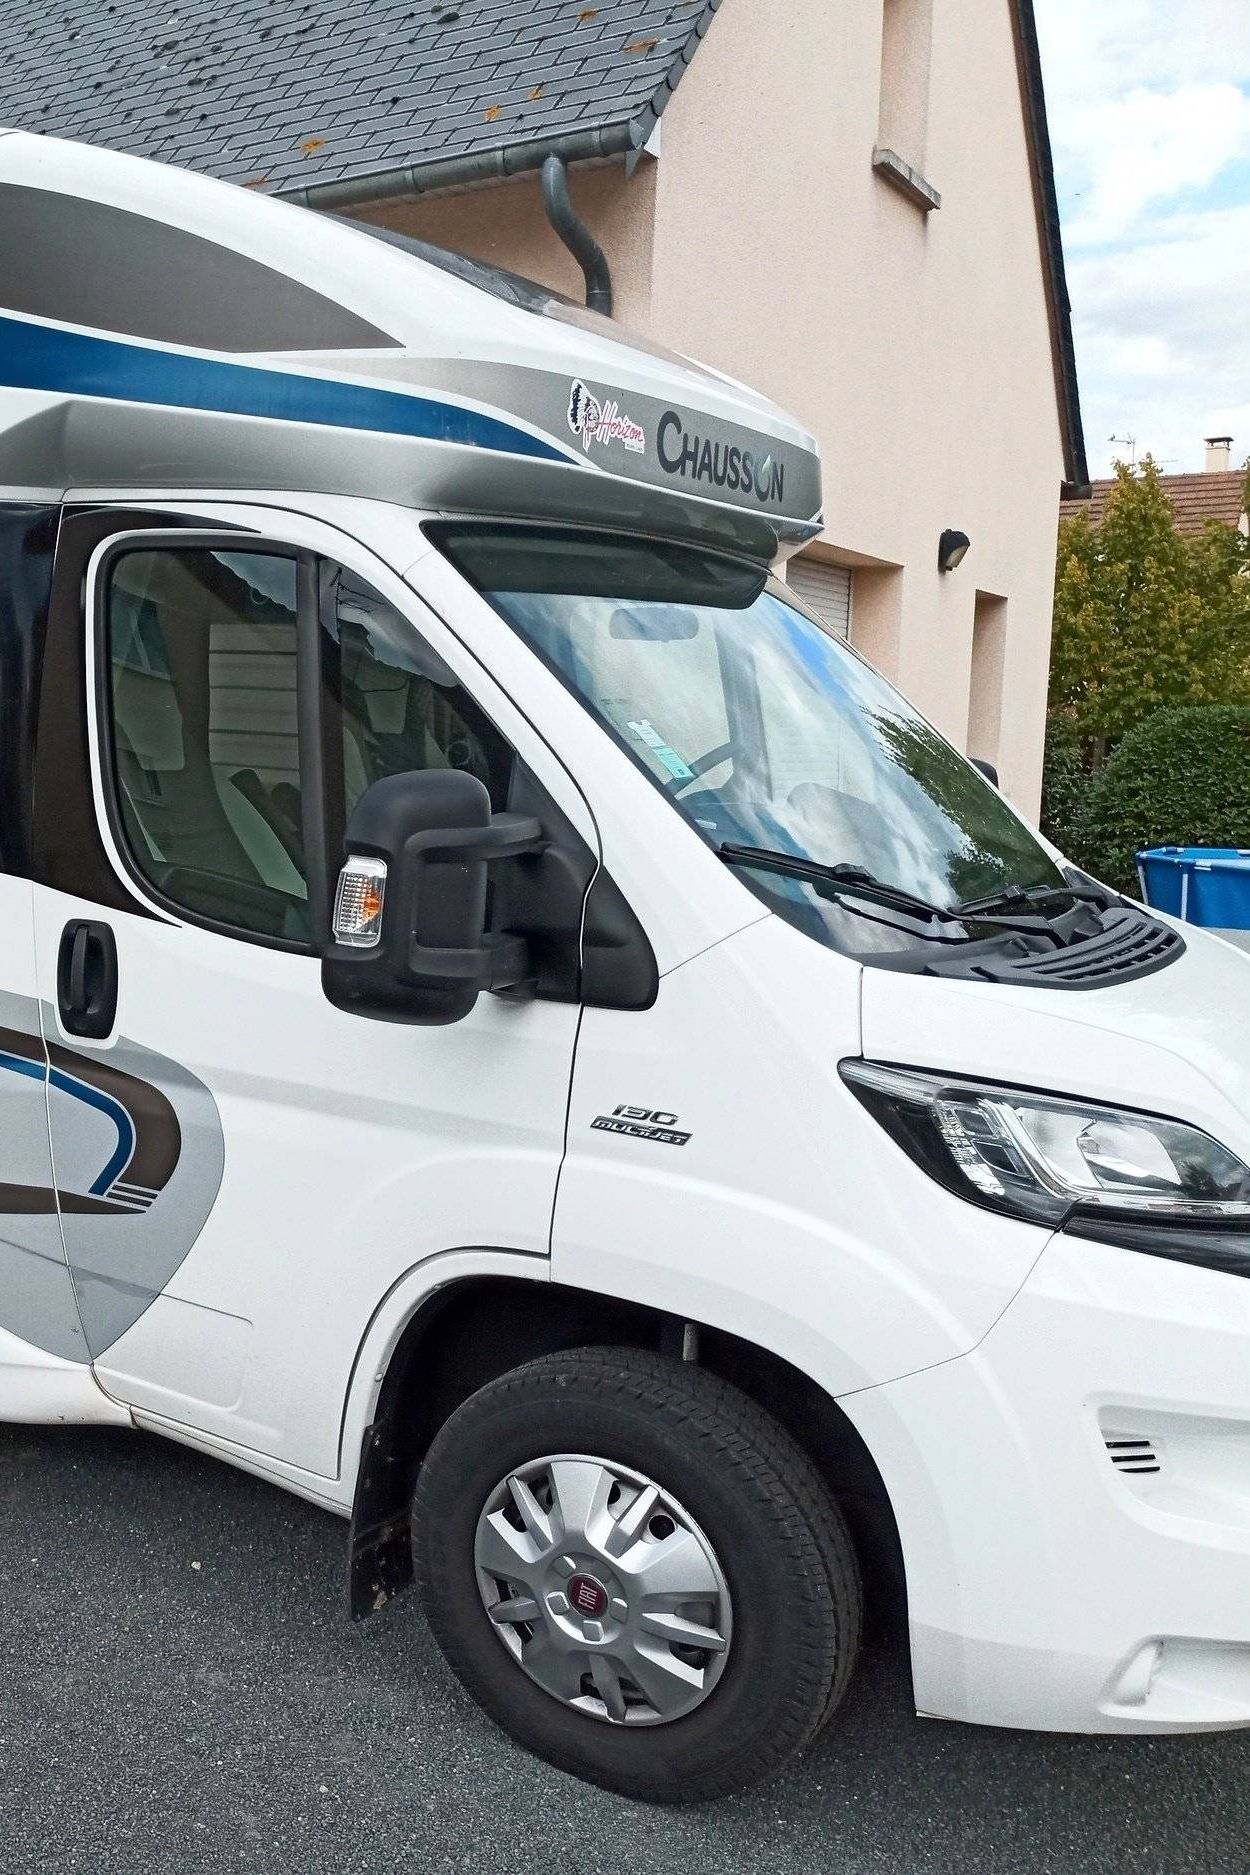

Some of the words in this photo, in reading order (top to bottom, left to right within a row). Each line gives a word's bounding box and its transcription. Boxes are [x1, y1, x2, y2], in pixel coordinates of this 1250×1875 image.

[656, 410, 784, 502] CHAUSSON
[612, 1103, 679, 1126] 130
[578, 1582, 598, 1610] FIAT
